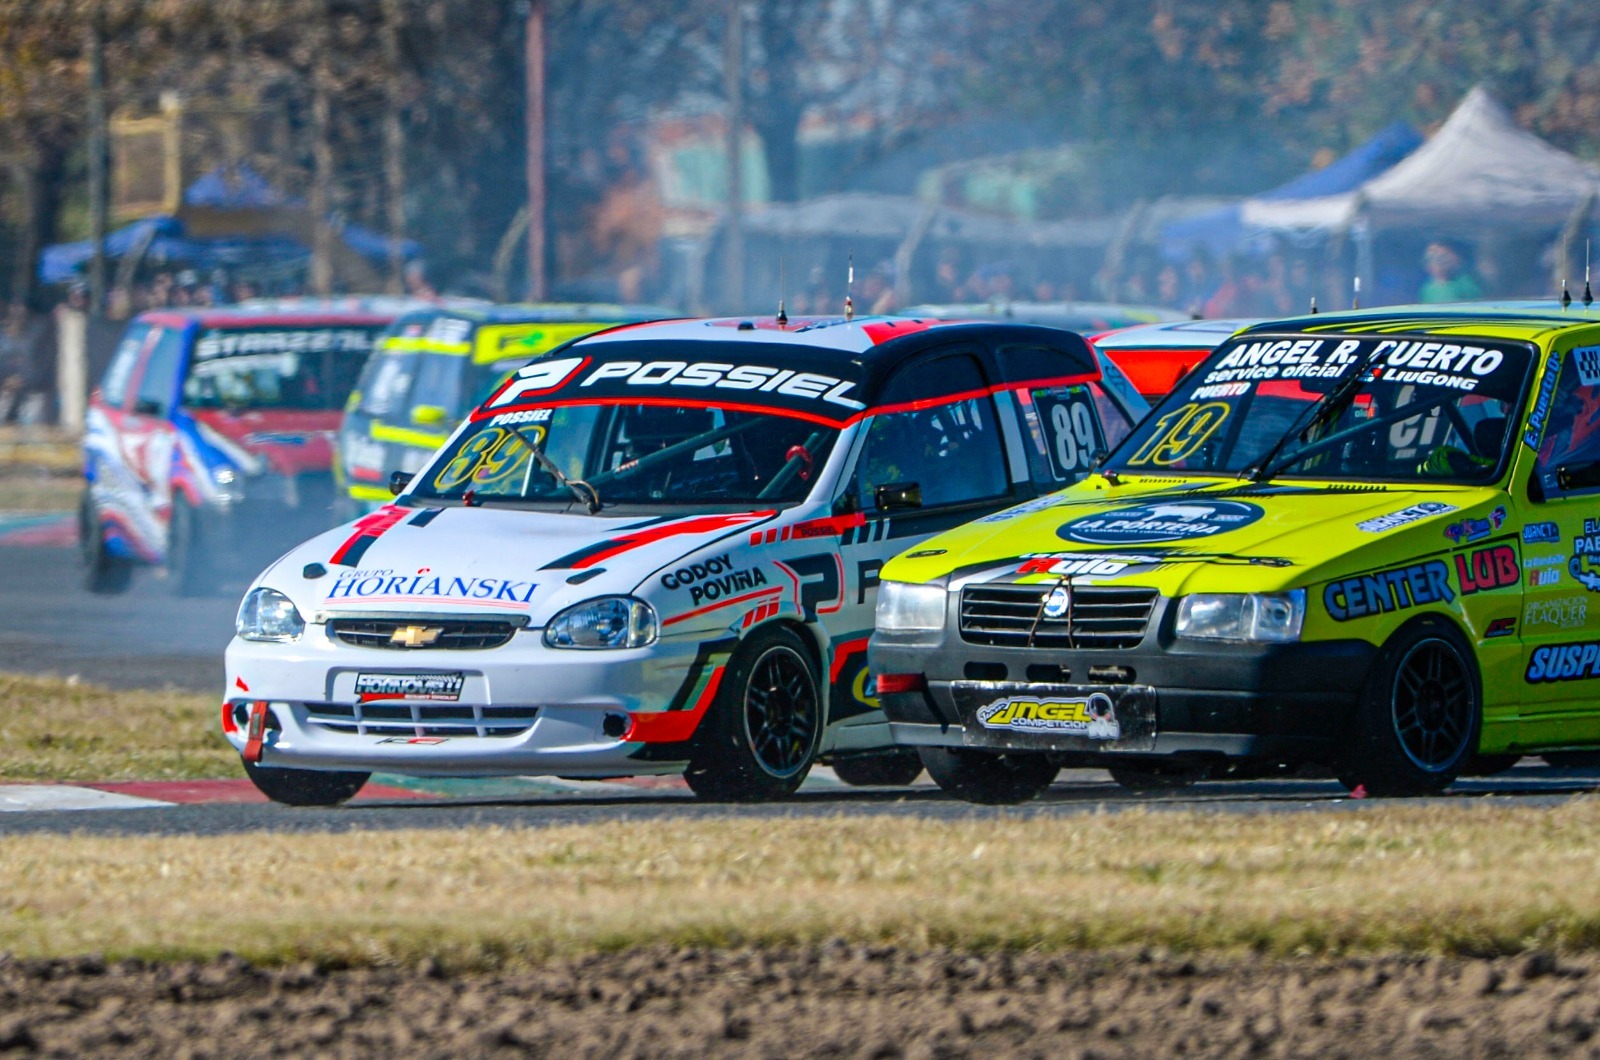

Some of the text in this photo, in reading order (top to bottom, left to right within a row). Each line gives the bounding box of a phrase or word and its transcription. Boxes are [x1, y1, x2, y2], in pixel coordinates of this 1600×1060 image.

[1204, 362, 1348, 384] service oficial
[1214, 339, 1504, 376] ANGEL R. PUERTO
[580, 361, 867, 411] POSSIEL
[1190, 381, 1252, 401] PUERTO
[1530, 372, 1557, 429] Puerto
[489, 408, 554, 427] POSSIEL
[1051, 401, 1098, 470] 89
[1127, 401, 1231, 466] 19
[433, 425, 546, 490] 89
[326, 571, 541, 603] HORIANSKI
[340, 569, 394, 579] GRUPO
[661, 553, 734, 591] GODOY
[689, 566, 767, 607] POVIÑA
[1324, 546, 1520, 621] CENTER LUB
[1525, 604, 1587, 625] FLAQUER
[987, 701, 1092, 724] ANGEL
